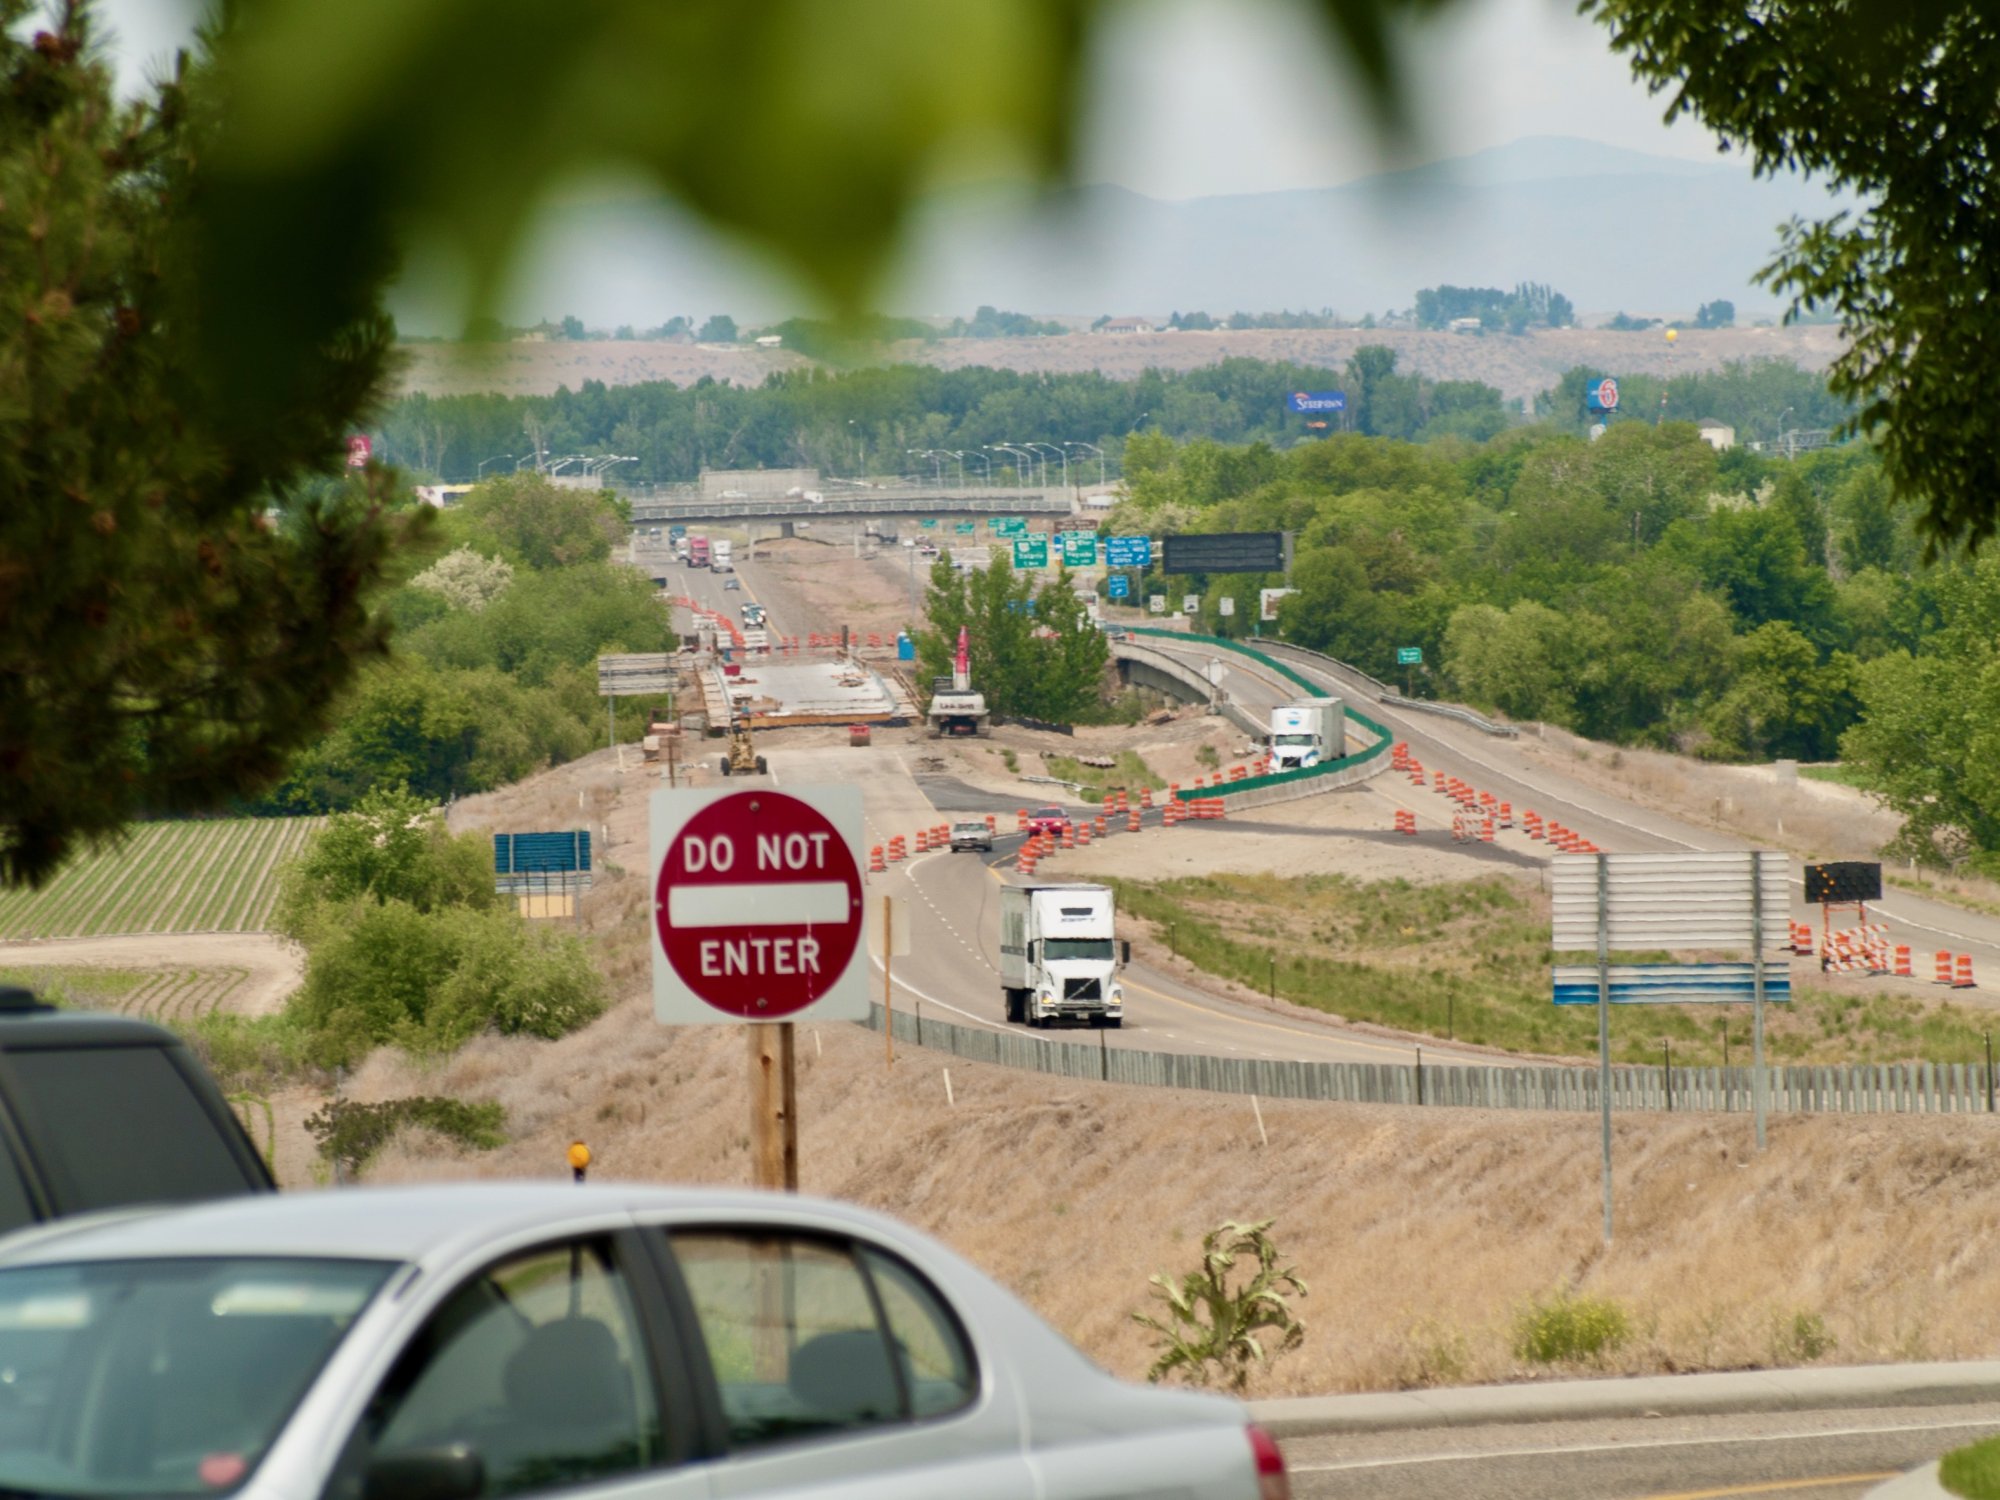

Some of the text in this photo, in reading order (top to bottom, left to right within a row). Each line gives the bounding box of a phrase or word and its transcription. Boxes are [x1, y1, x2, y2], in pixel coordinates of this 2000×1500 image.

[683, 832, 830, 873] DO NOT
[699, 938, 821, 977] ENTER
